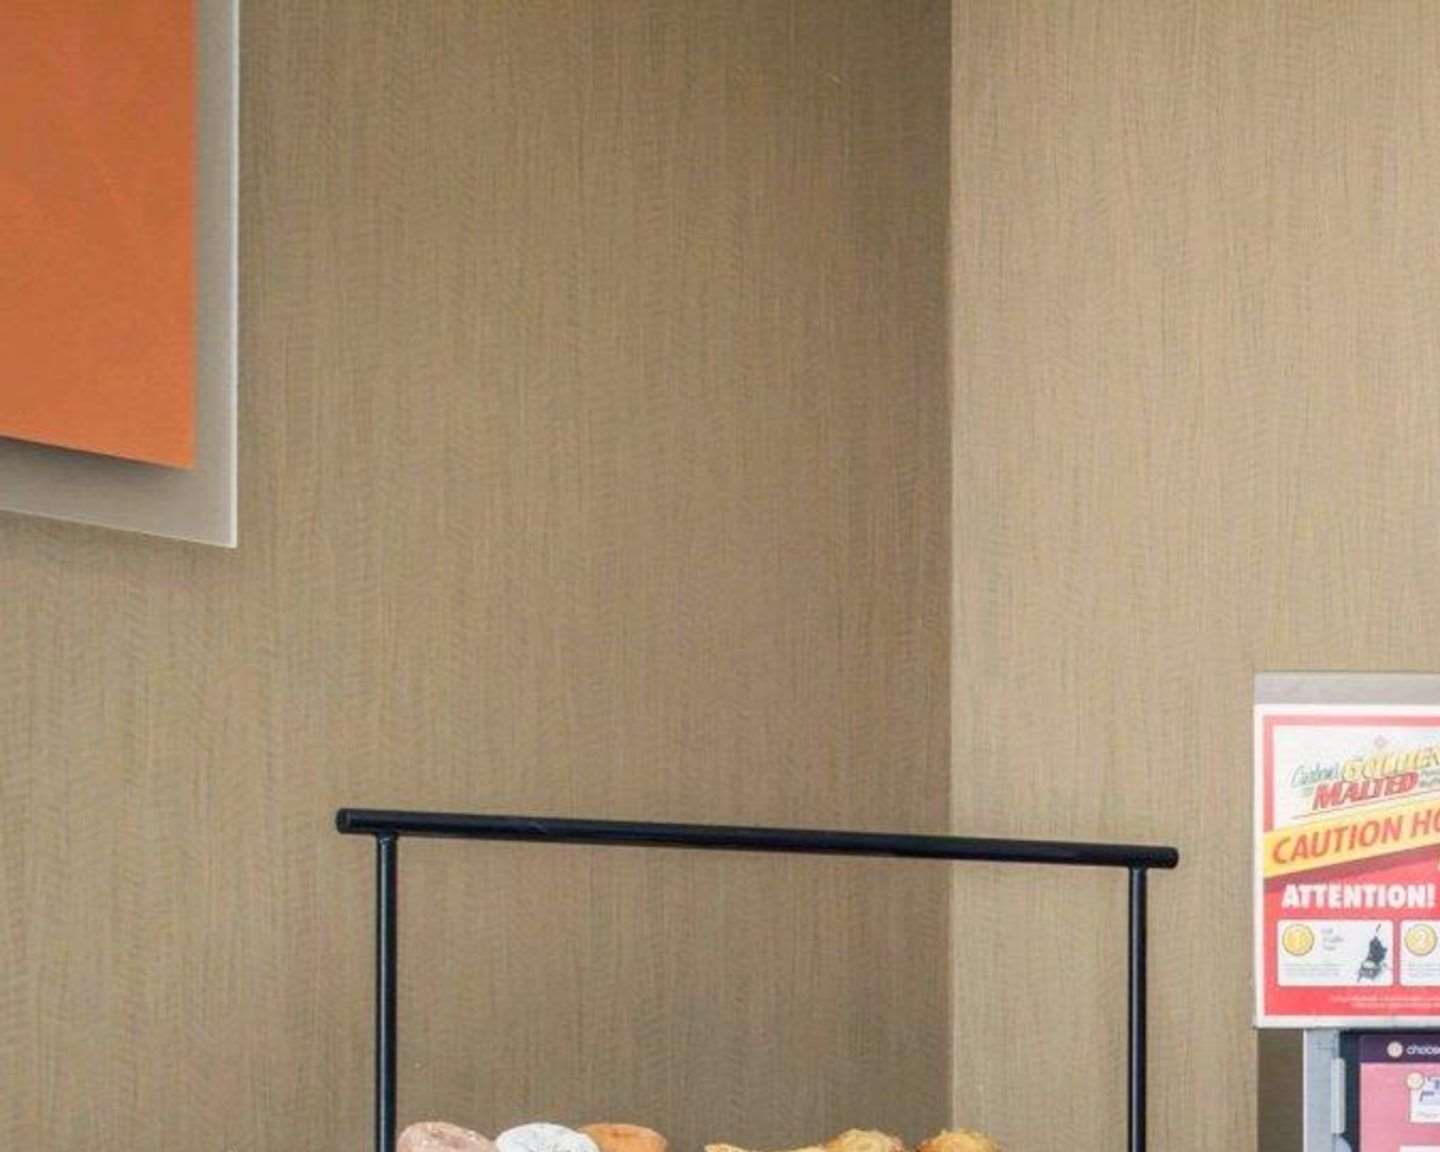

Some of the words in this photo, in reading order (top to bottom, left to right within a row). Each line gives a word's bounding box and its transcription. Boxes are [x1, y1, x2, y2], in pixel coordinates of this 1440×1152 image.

[1312, 771, 1420, 811] MALTED
[1272, 815, 1403, 865] CAUTION
[1281, 883, 1436, 909] ATTENTION!
